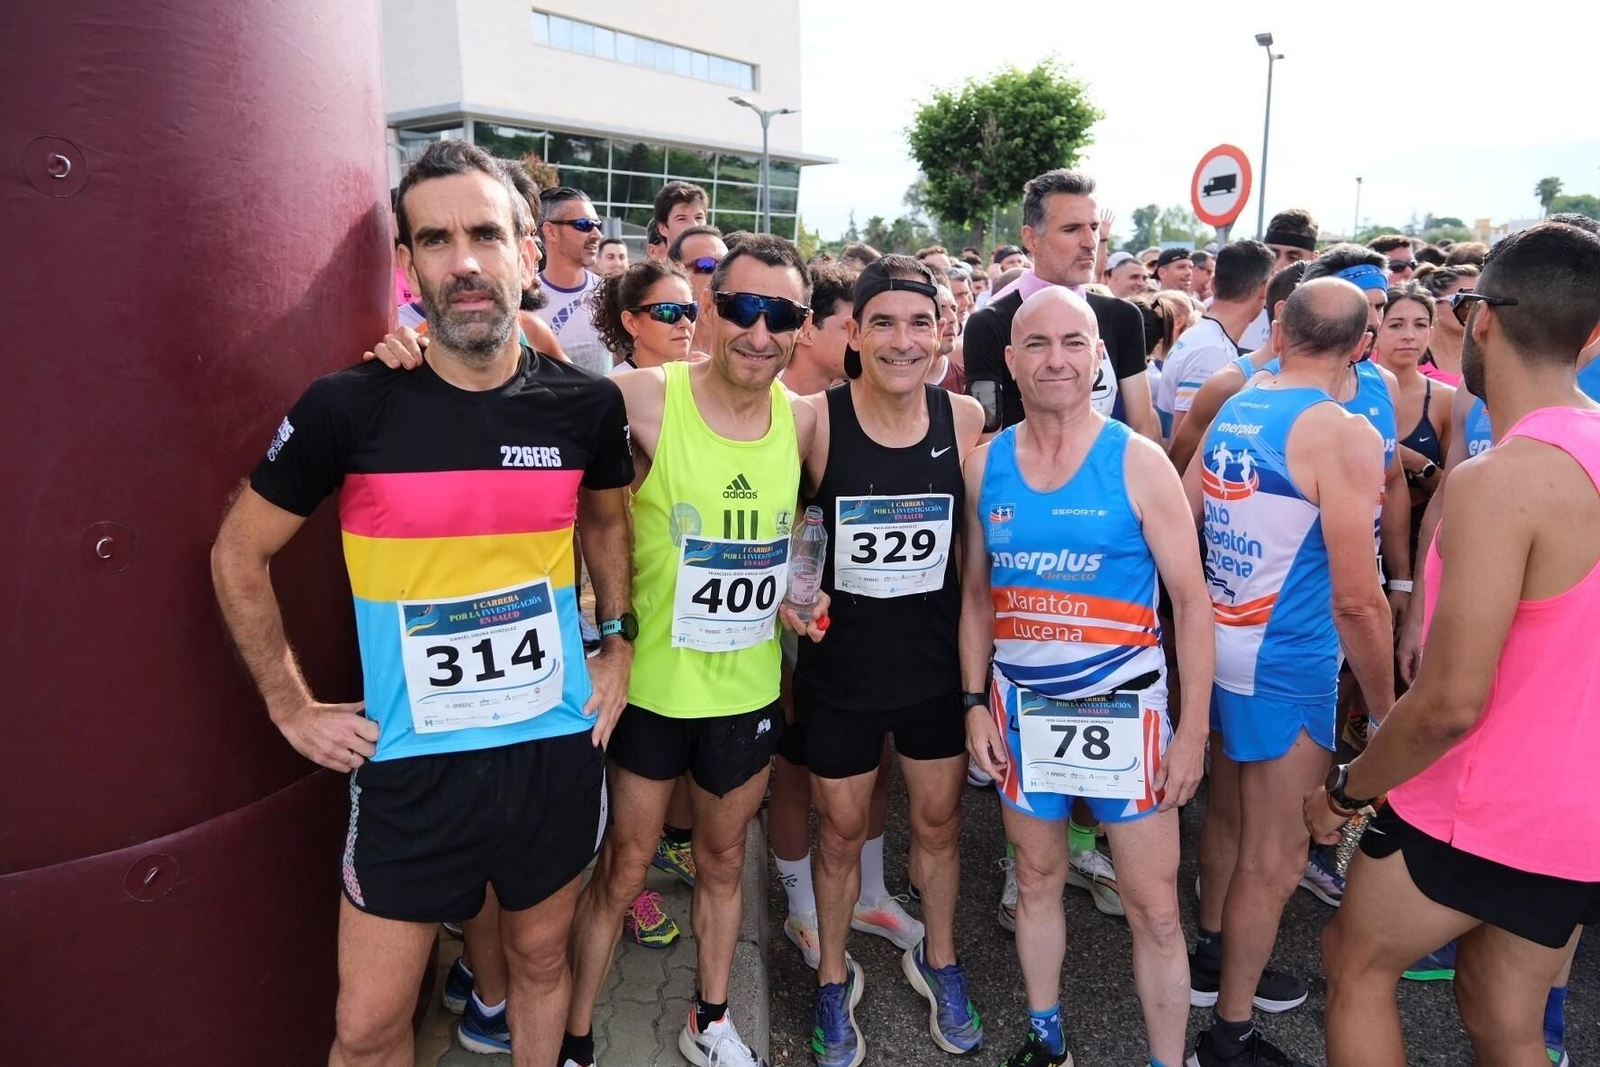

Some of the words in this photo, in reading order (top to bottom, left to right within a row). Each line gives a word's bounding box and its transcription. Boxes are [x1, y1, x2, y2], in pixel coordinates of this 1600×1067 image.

[1217, 421, 1263, 436] enerplus
[500, 445, 562, 467] 226ERS
[722, 489, 757, 499] adidas
[896, 505, 943, 514] INVESTIGACIÓN
[1052, 508, 1096, 516] GSPORT
[850, 529, 936, 564] 329
[992, 549, 1104, 576] enerplus
[1041, 572, 1097, 581] directo
[479, 594, 519, 609] CARRERA
[691, 575, 776, 614] 400
[1007, 591, 1088, 617] Maratón
[449, 612, 468, 622] POR
[469, 611, 481, 620] LA
[481, 596, 542, 617] INVESTIGACIÓN
[480, 615, 493, 625] EN
[493, 611, 520, 624] SALUD
[1013, 618, 1083, 643] Lucena
[426, 628, 546, 688] 314
[1079, 701, 1132, 709] INVESTIGACIÓN
[1050, 725, 1111, 761] 78
